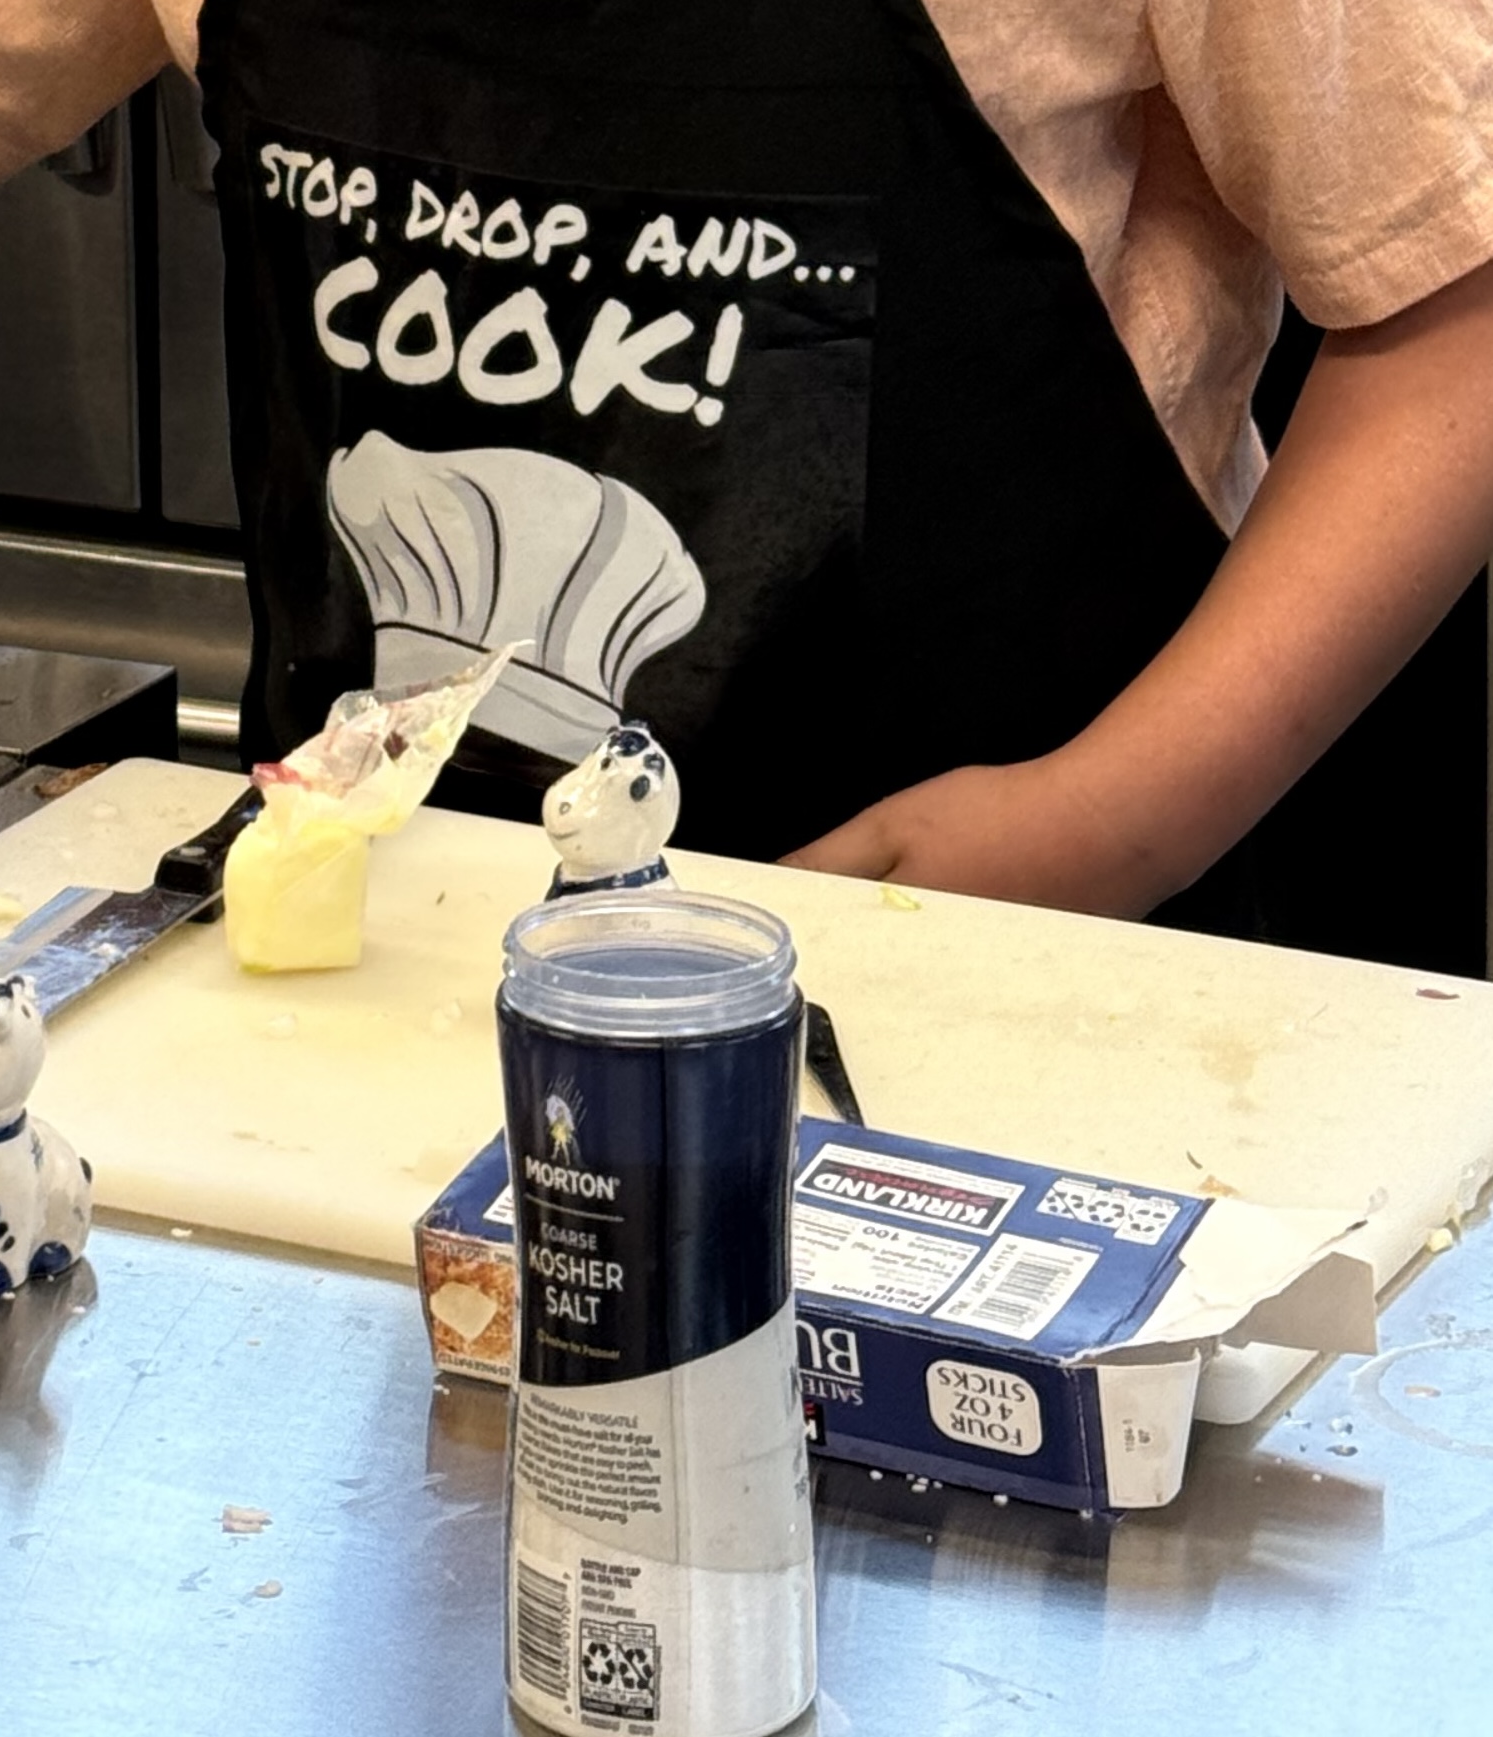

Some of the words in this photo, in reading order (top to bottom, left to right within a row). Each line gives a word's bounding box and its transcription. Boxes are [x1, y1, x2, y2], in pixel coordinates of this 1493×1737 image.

[261, 143, 377, 244] STOP,
[406, 180, 591, 282] DROP,
[627, 214, 855, 282] AND...
[314, 257, 742, 426] COOK!
[813, 1172, 988, 1225] KIRKLAND
[541, 1222, 598, 1251] COARSE
[862, 1226, 900, 1241] 100
[529, 1241, 624, 1292] KOSHER
[546, 1285, 601, 1325] SALT
[936, 1367, 1026, 1403] STICKS
[953, 1391, 991, 1417] OZ
[997, 1402, 1014, 1421] 4
[950, 1412, 1023, 1447] FOUR
